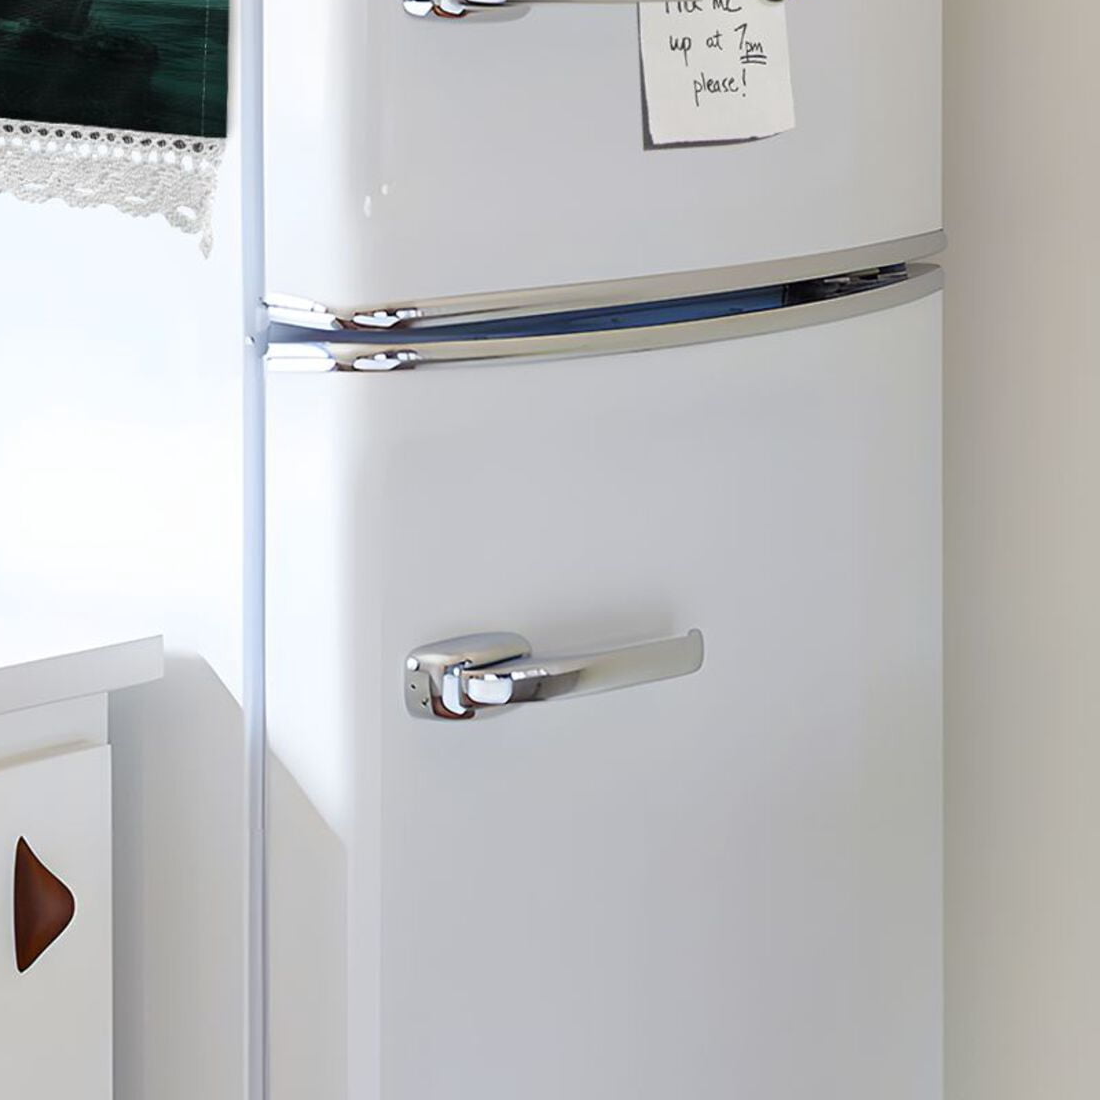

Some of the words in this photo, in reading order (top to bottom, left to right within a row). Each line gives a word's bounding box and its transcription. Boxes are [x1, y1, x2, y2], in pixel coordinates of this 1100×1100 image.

[669, 35, 692, 66] up
[706, 30, 723, 51] at
[693, 68, 747, 107] please!
